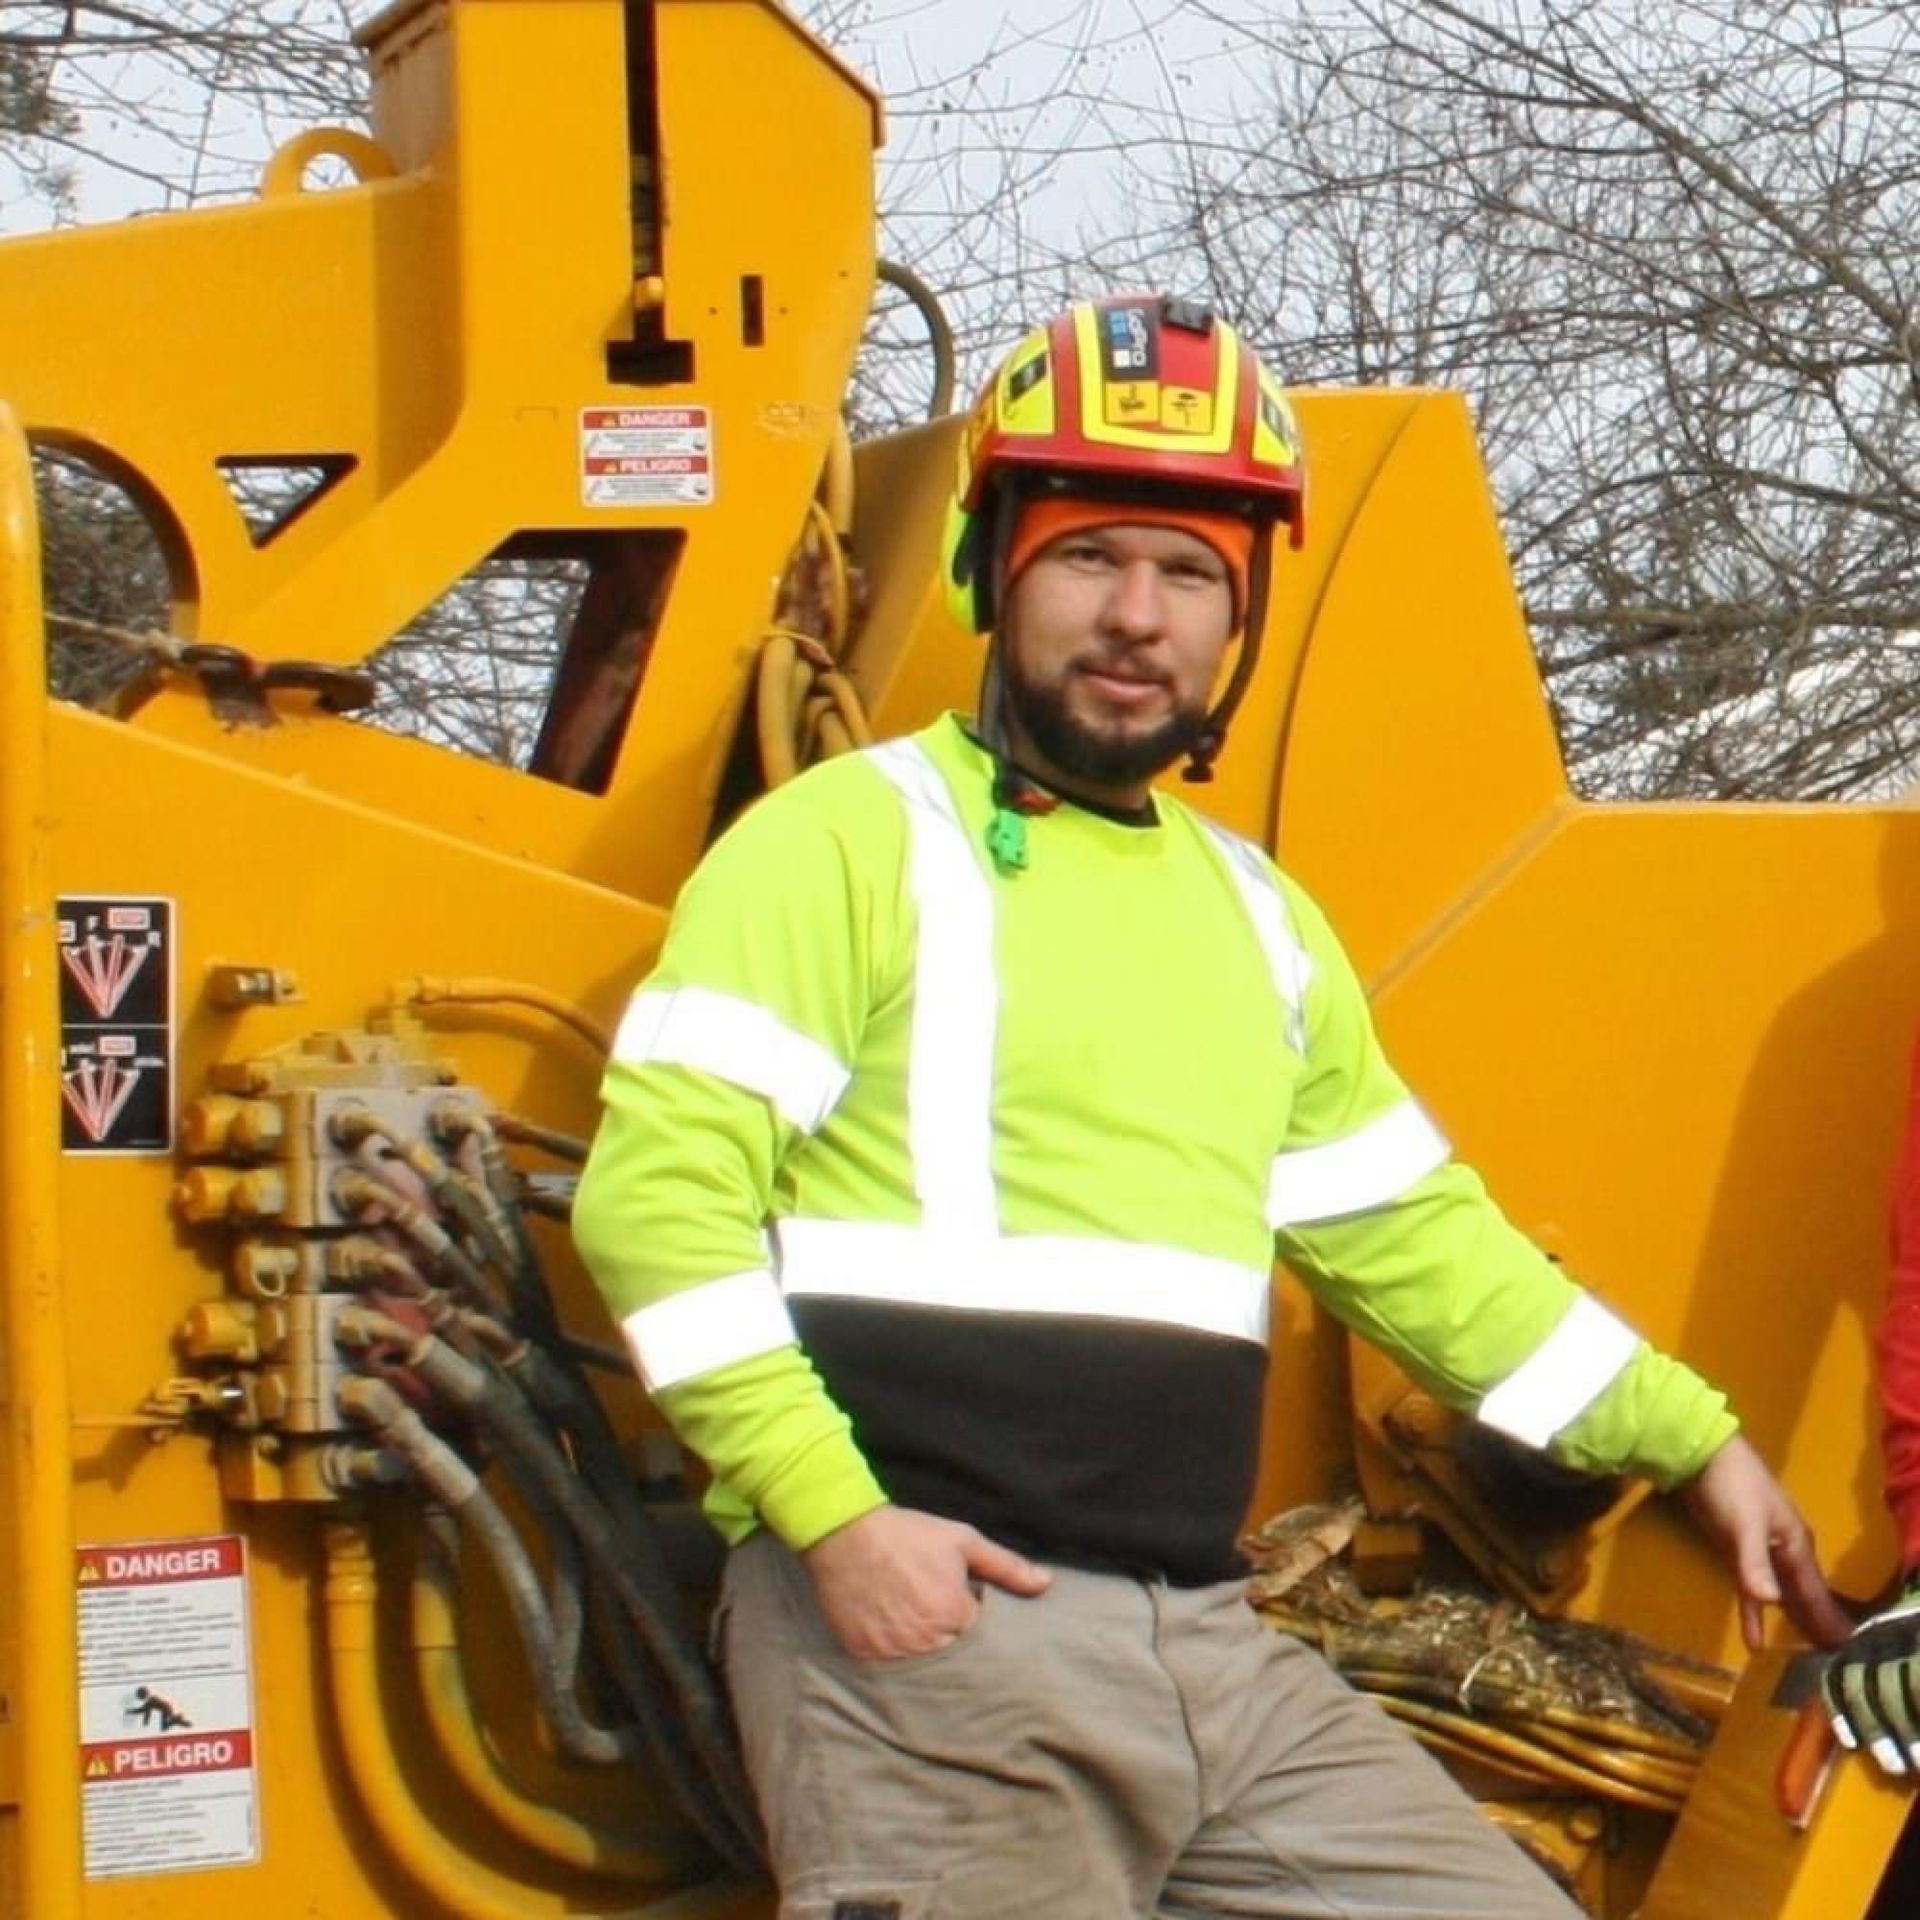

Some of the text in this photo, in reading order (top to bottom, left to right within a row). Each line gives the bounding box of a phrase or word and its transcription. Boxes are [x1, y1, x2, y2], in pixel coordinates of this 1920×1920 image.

[619, 412, 690, 426] DANGER
[621, 458, 692, 473] PELIGRO
[106, 1548, 221, 1579] DANGER
[114, 1740, 233, 1774] PELIGRO
